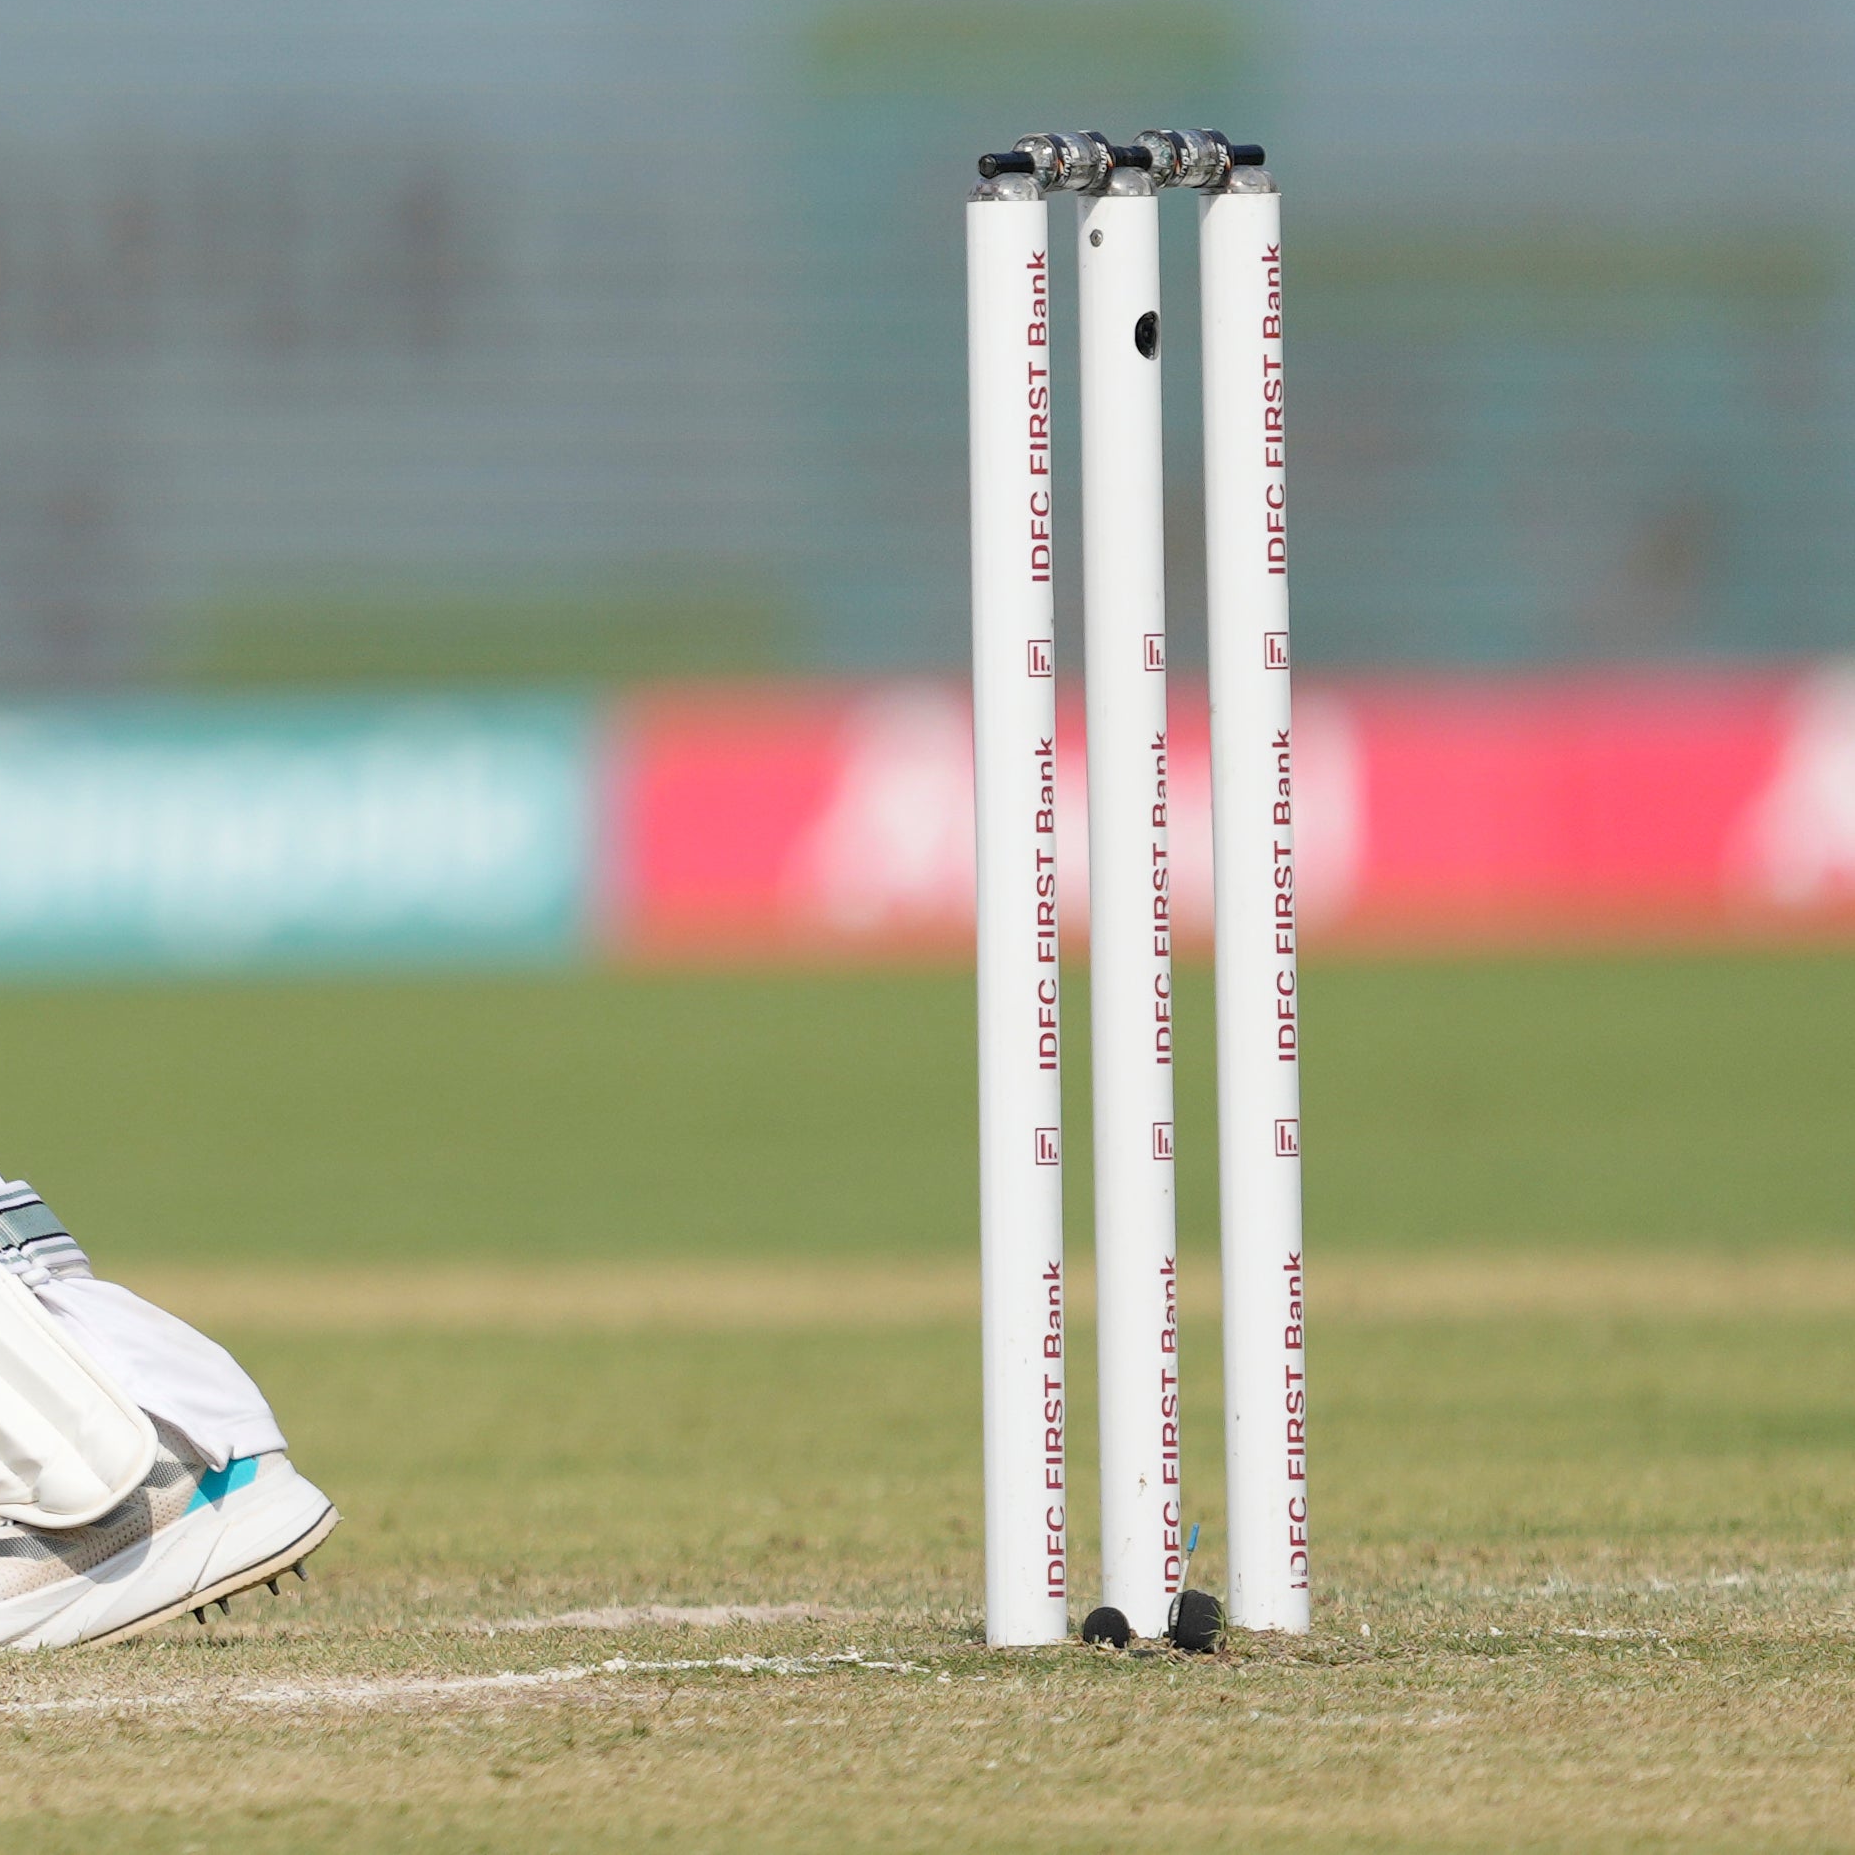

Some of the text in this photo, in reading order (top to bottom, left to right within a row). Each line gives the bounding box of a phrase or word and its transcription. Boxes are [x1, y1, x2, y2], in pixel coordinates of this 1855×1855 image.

[1026, 249, 1051, 582] IDFC FIRST Bank
[1261, 243, 1287, 575] IDFC FIRST Bank
[1035, 736, 1058, 1070] IDFC FIRST Bank
[1150, 731, 1172, 1064] IDFC FIRST Bank
[1272, 728, 1296, 1061] IDFC FIRST Bank
[1042, 1260, 1066, 1598] IDFC FIRST Bank
[1159, 1255, 1181, 1593] IDFC FIRST Bank
[1283, 1250, 1308, 1589] IDFC FIRST Bank
